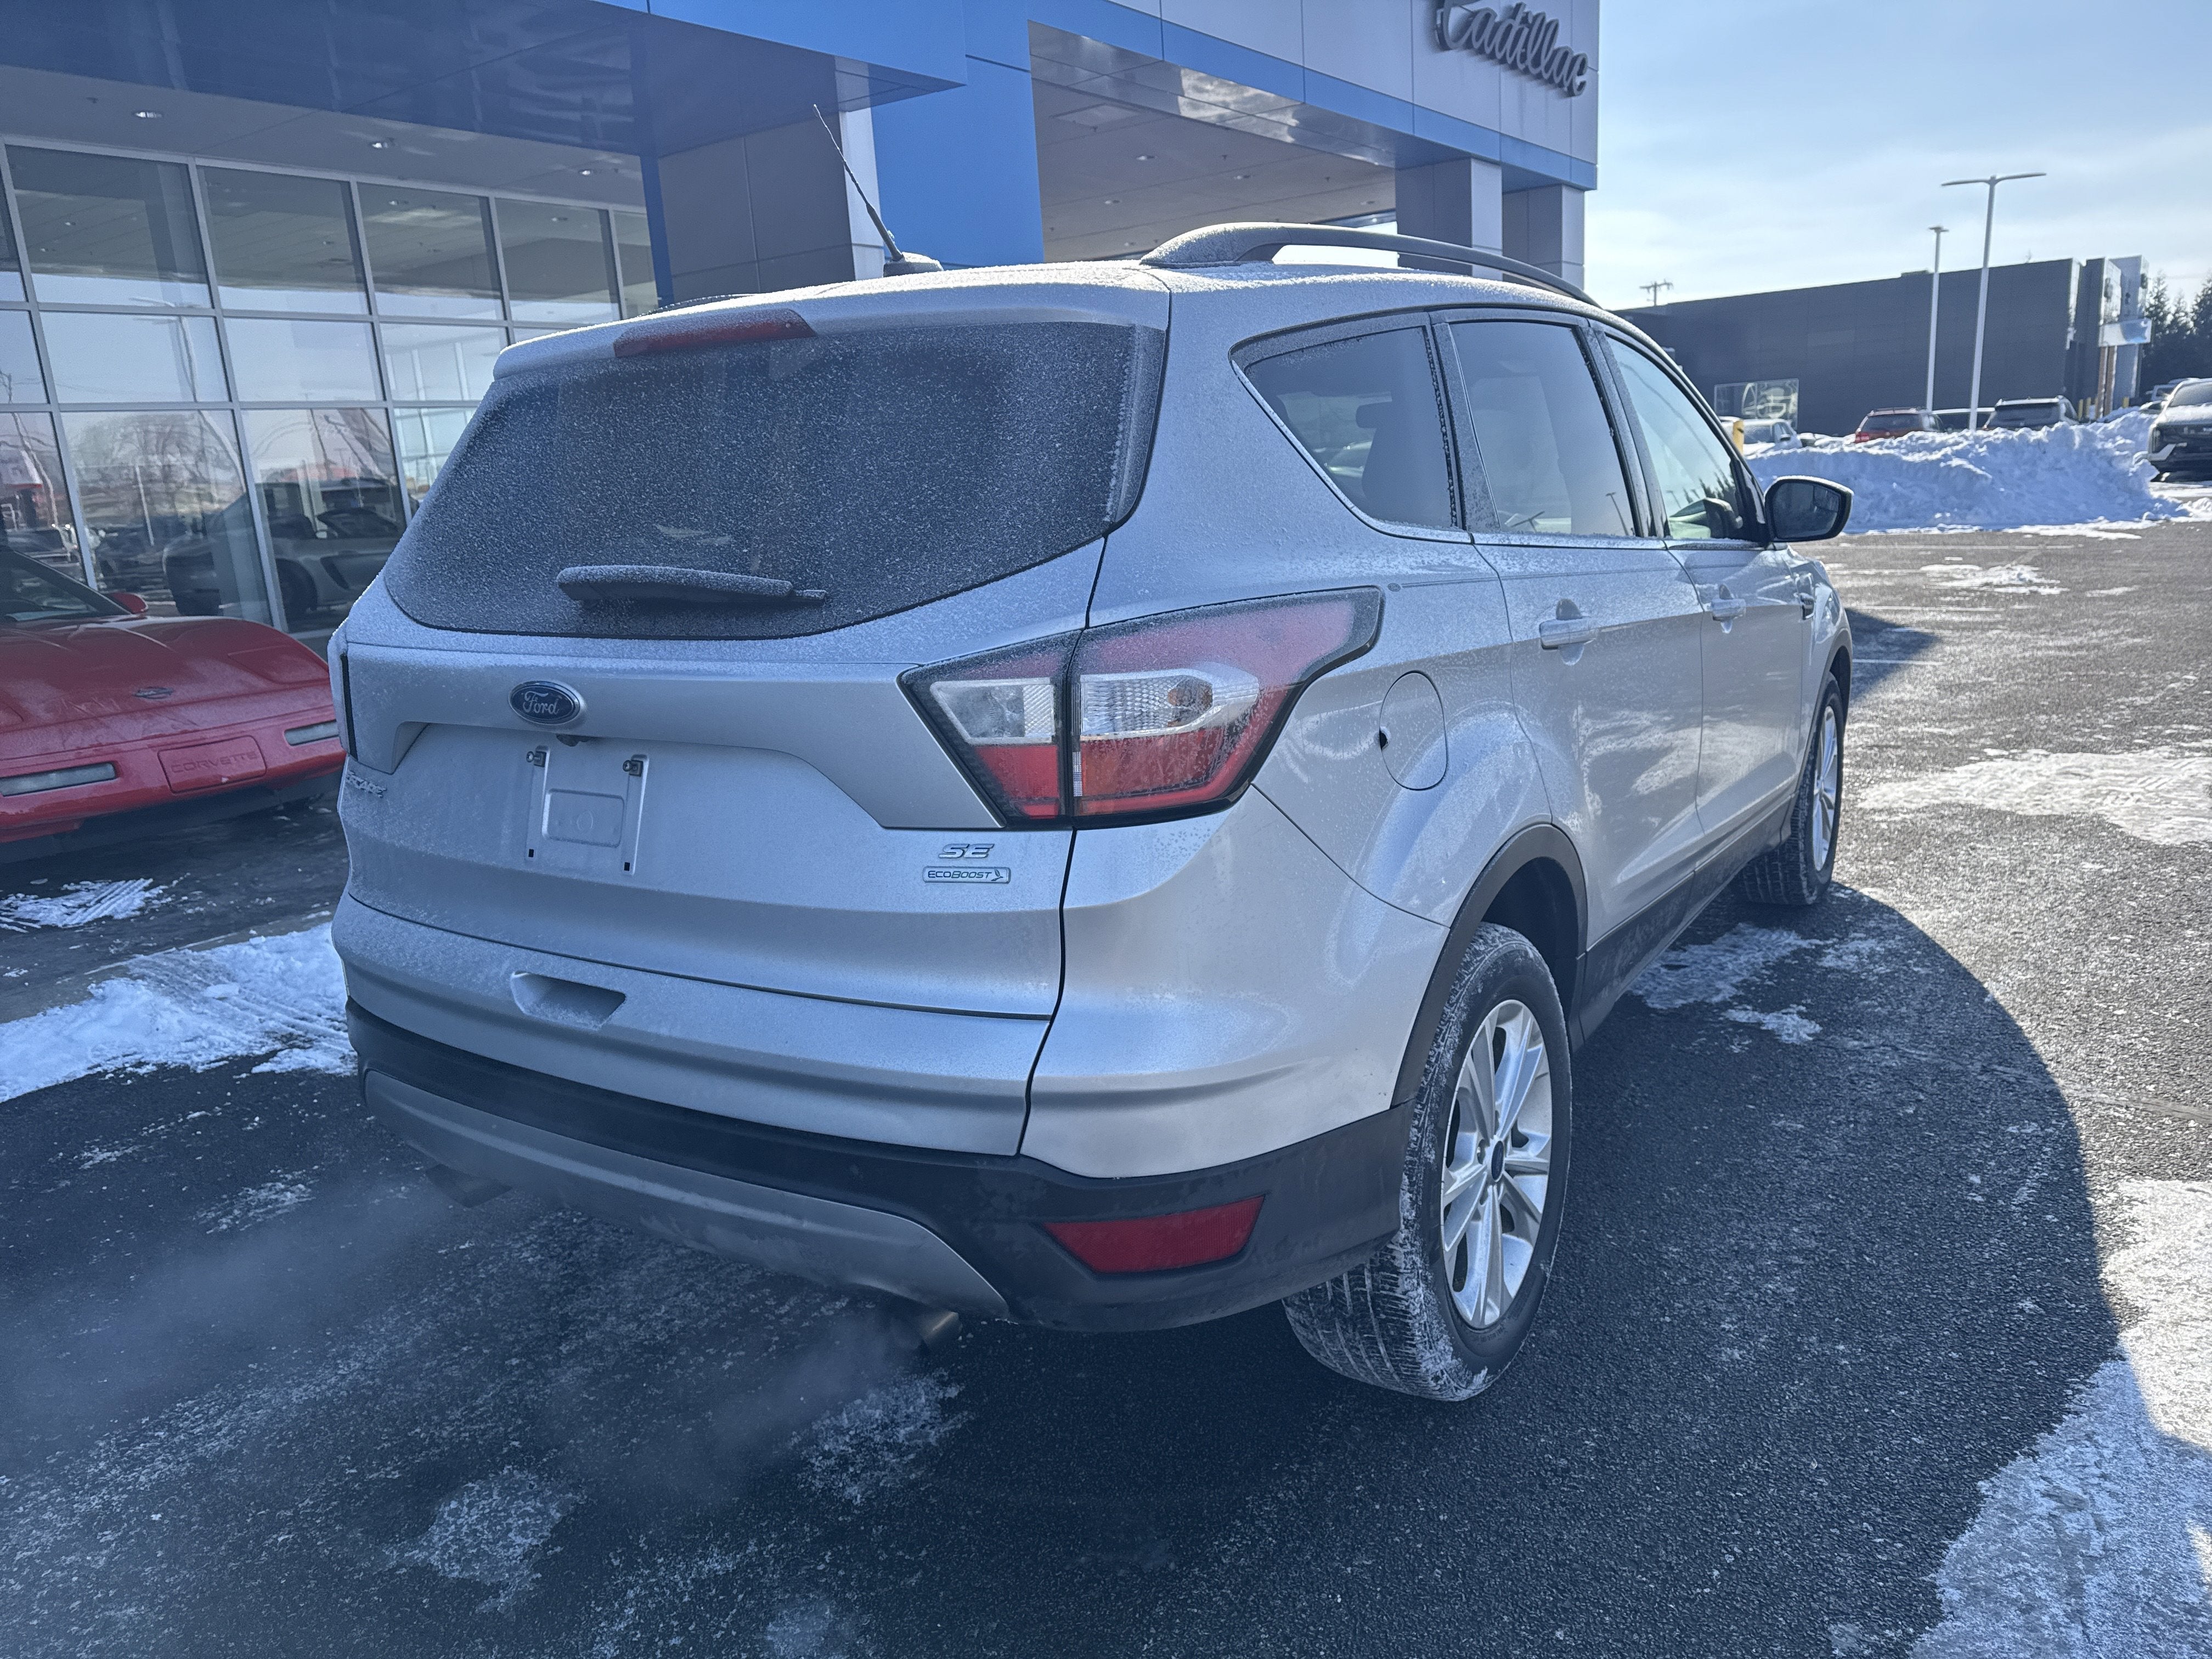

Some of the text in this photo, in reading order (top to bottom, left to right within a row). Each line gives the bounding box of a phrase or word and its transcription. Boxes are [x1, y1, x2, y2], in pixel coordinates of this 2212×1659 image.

[1435, 0, 1588, 96] Cadillac
[522, 690, 560, 715] Ford
[171, 751, 257, 773] CORVETTE
[938, 843, 995, 859] SE
[928, 870, 992, 878] ECOBOOST
